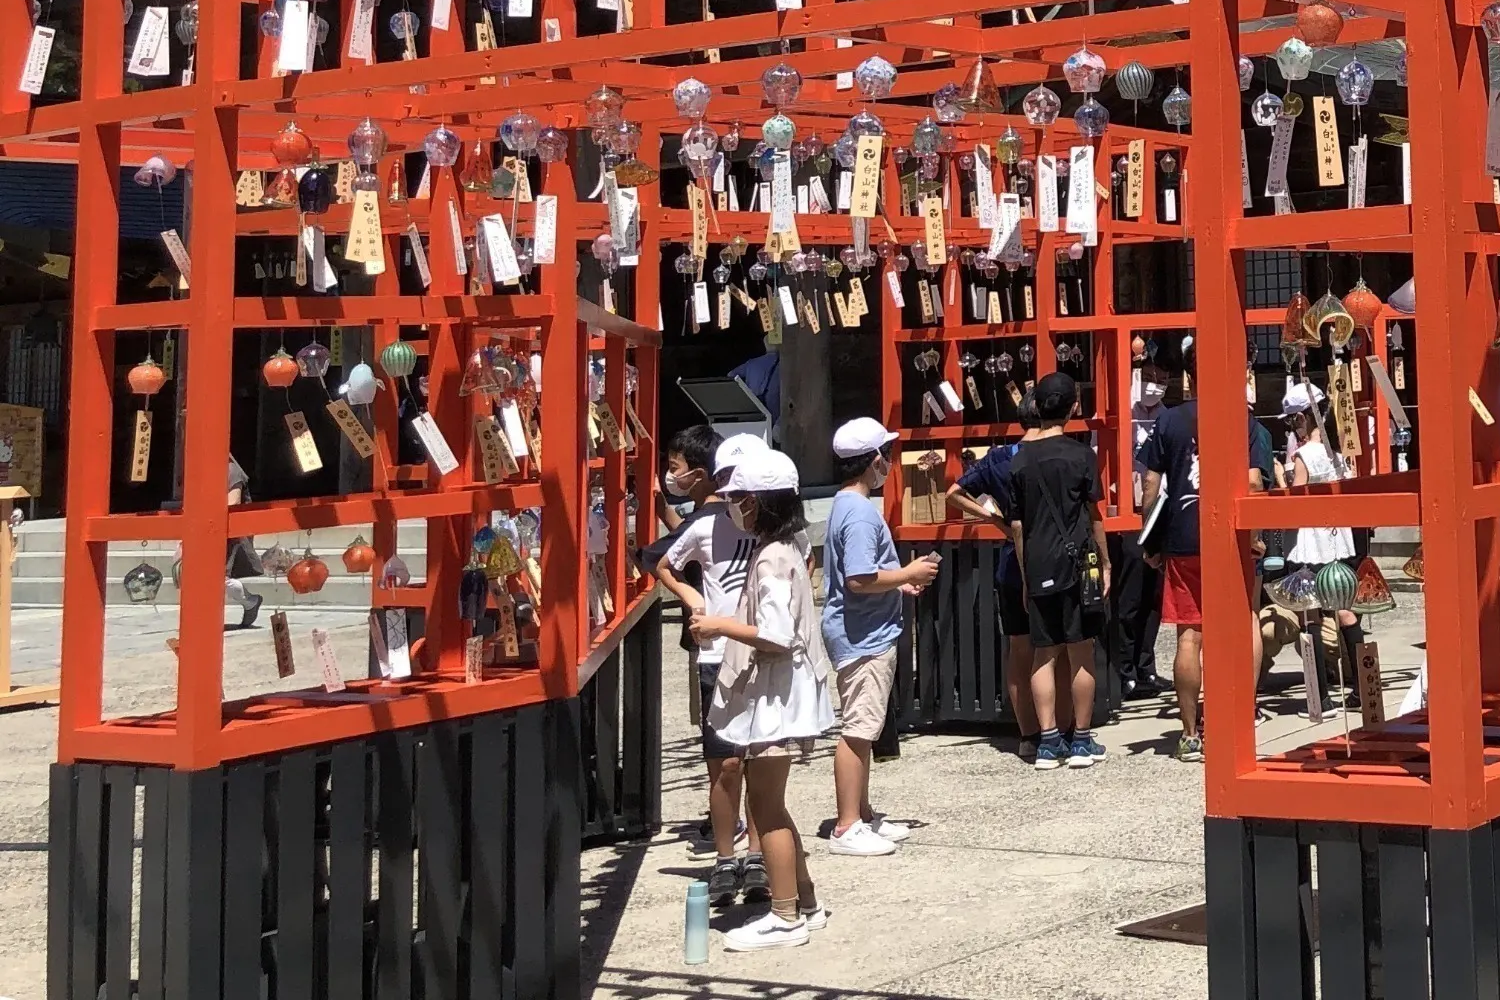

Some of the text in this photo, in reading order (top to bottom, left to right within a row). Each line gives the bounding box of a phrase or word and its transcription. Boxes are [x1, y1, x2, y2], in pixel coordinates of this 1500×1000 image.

[1322, 129, 1333, 180] 白山神社
[860, 164, 872, 211] 白山神社
[366, 216, 378, 257] 白山神社
[931, 223, 941, 260] 白山神社
[1340, 399, 1355, 450] 白山神社
[1366, 675, 1379, 723] 白山神社
